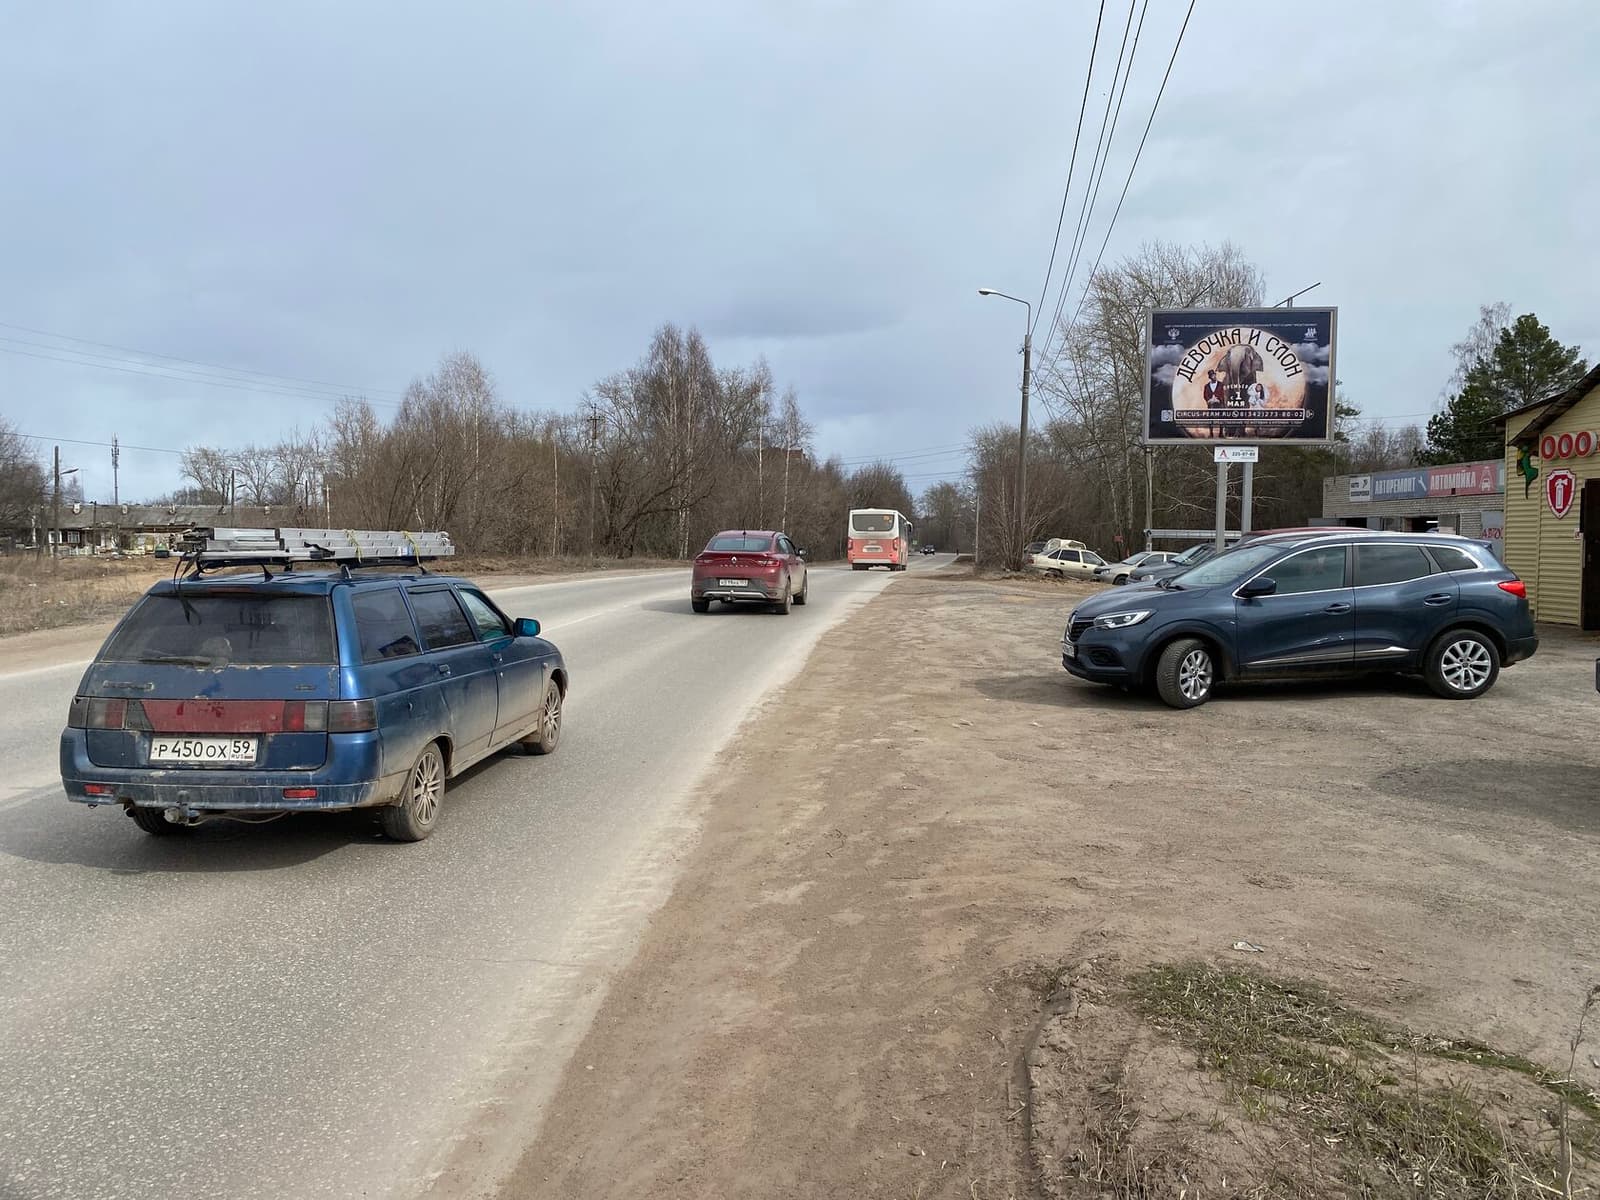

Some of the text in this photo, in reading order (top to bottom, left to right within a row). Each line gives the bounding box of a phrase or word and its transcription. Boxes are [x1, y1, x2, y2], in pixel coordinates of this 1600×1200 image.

[1177, 328, 1303, 383] ДЕВОЧКА И СЛОН
[1235, 391, 1242, 400] 1
[1374, 477, 1416, 495] АВТОРЕМОНТ
[1430, 469, 1476, 490] АВТОМОЙКА
[232, 740, 250, 754] 59
